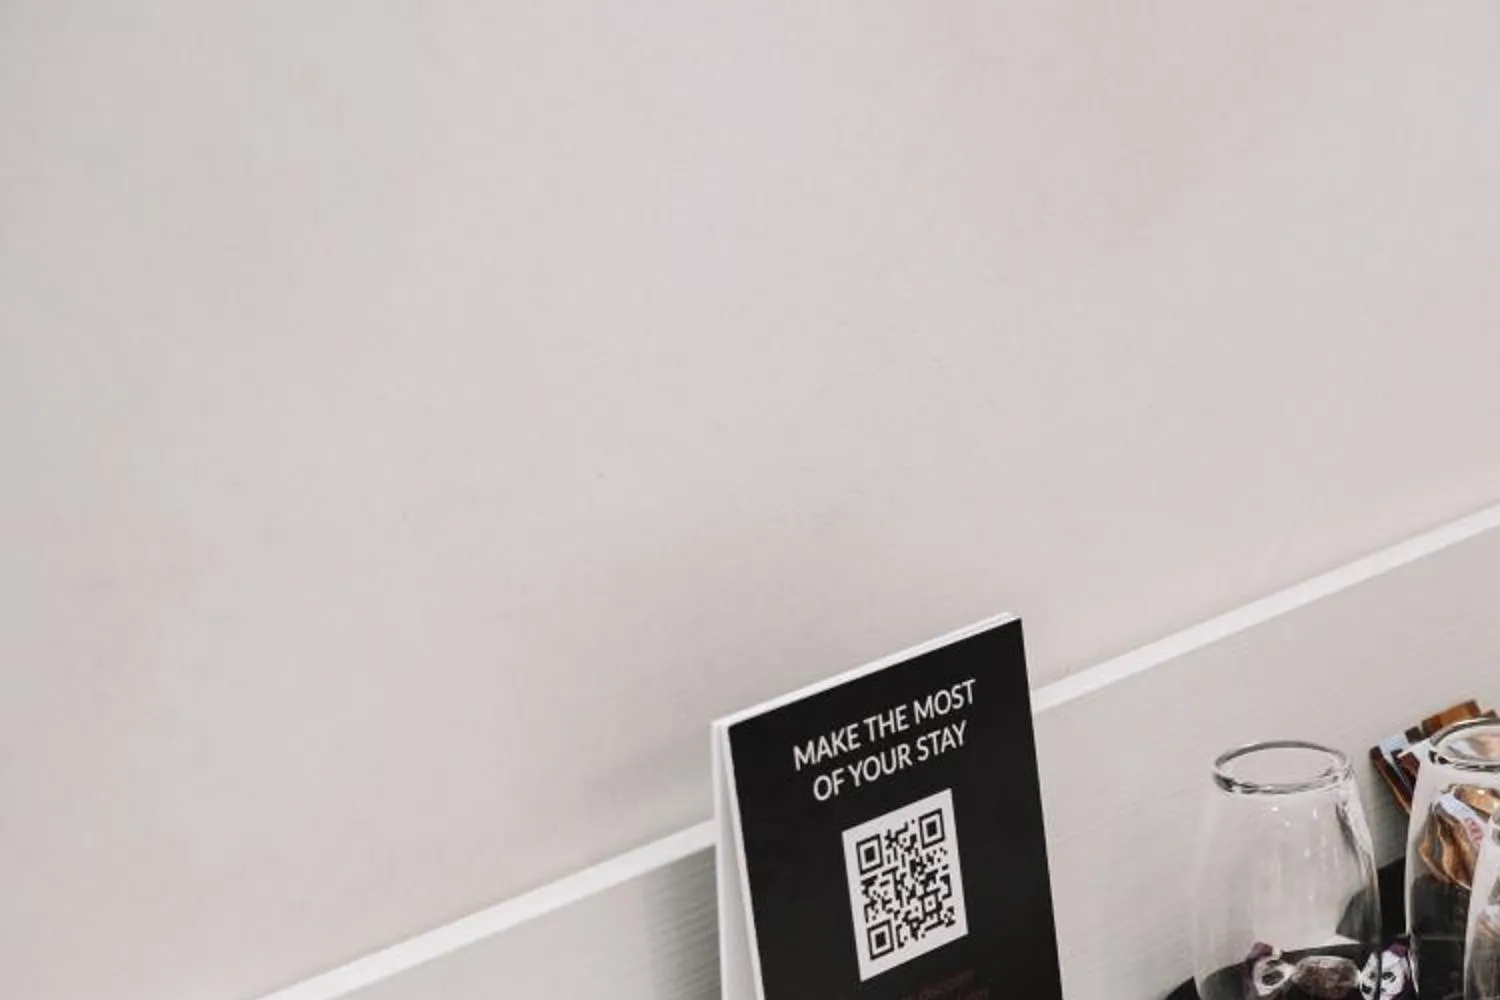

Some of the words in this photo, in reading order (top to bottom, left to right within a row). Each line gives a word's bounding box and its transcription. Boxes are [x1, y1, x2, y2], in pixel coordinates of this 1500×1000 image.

[793, 723, 861, 771] MAKE
[863, 704, 909, 743] THE
[913, 678, 976, 725] MOST
[813, 768, 846, 802] OF
[848, 743, 913, 788] YOUR
[915, 720, 968, 761] STAY
